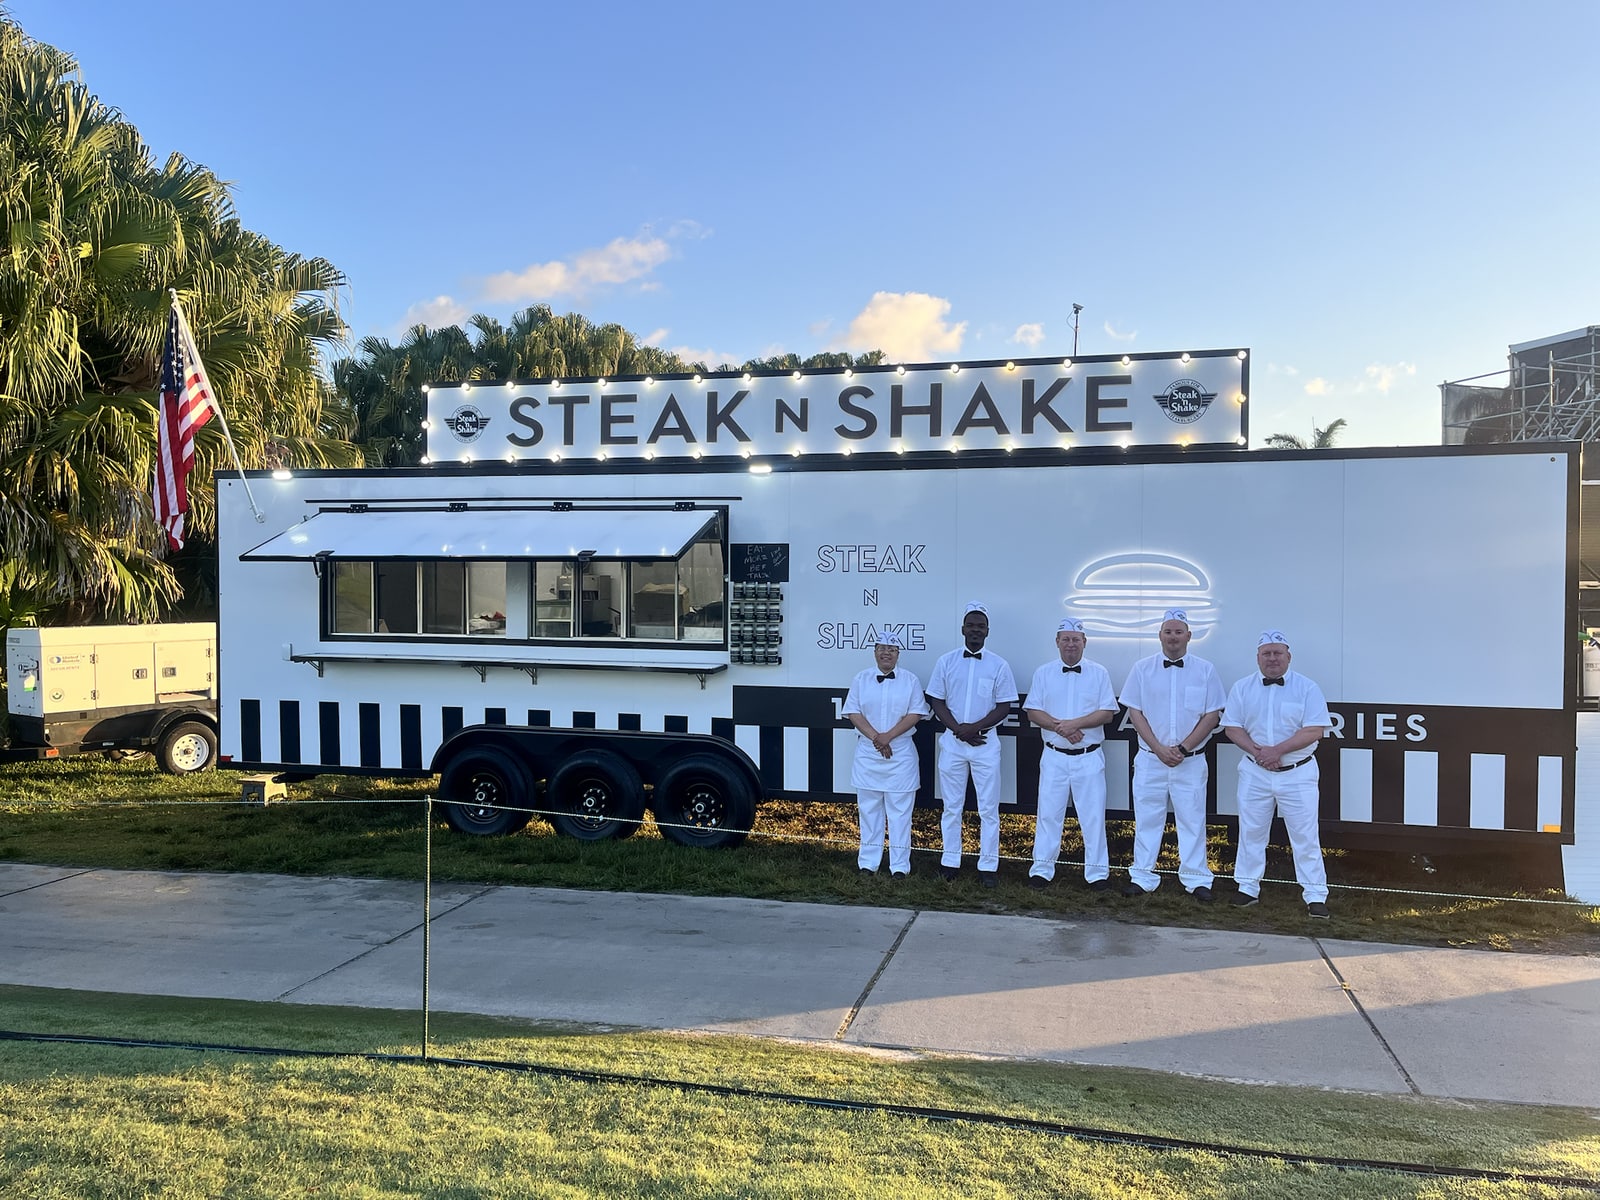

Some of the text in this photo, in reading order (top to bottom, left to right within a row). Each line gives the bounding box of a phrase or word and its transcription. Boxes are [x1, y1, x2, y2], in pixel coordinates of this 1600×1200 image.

[1172, 390, 1198, 399] Steak
[506, 374, 1133, 448] STEAK N SHAKE
[1171, 402, 1198, 411] Shake
[458, 414, 477, 422] Steak
[457, 424, 477, 433] Shake
[816, 544, 927, 573] STEAK
[863, 588, 879, 606] N
[1323, 711, 1428, 742] RIES
